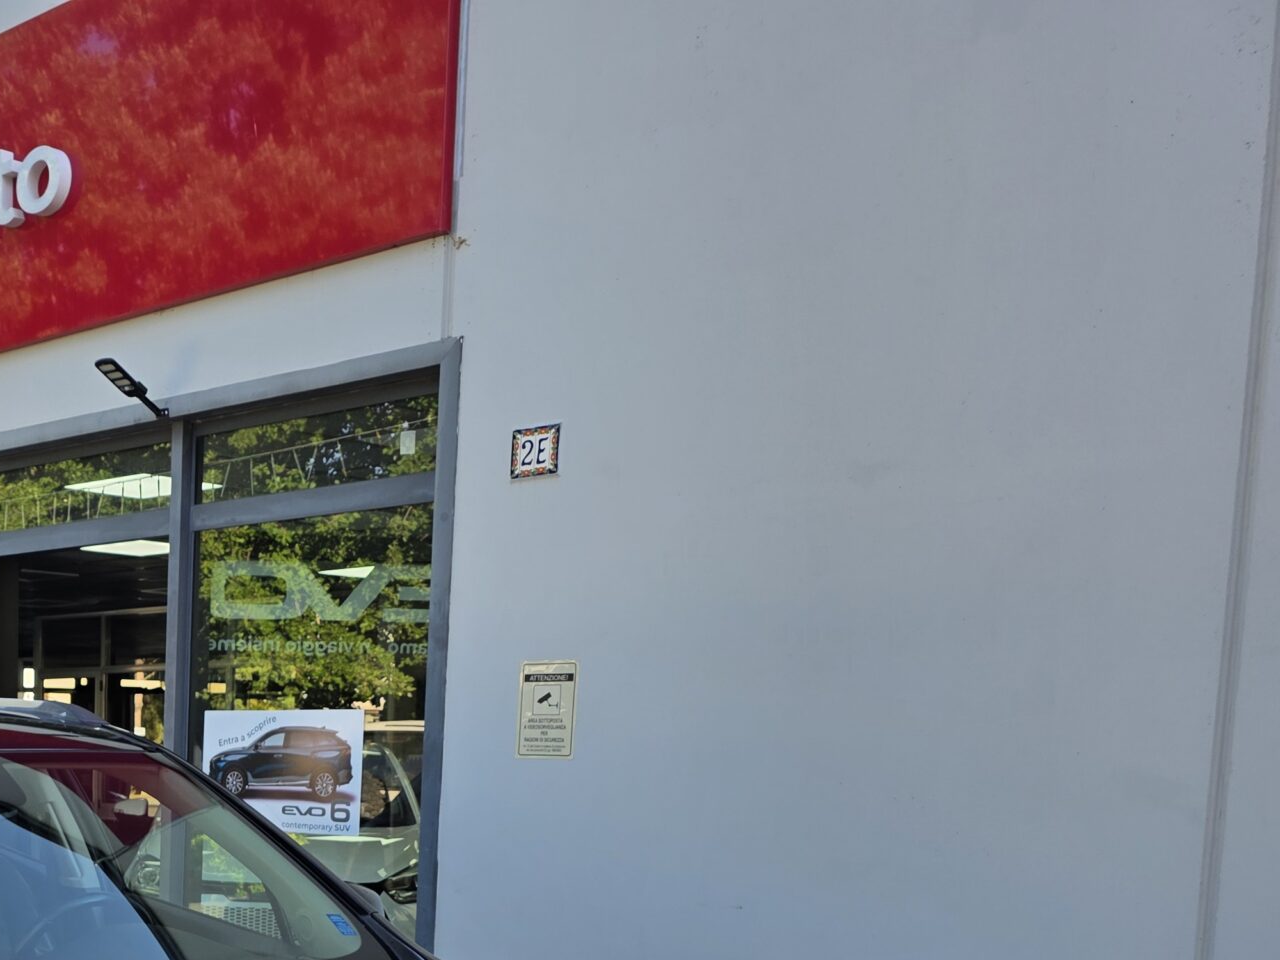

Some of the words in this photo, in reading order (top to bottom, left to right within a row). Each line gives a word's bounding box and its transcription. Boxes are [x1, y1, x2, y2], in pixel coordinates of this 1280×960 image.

[521, 437, 549, 466] 2E
[218, 737, 239, 747] Entra
[246, 716, 277, 739] scoprire
[330, 801, 350, 823] 6
[282, 822, 332, 832] contemporary
[334, 824, 351, 832] SUV
